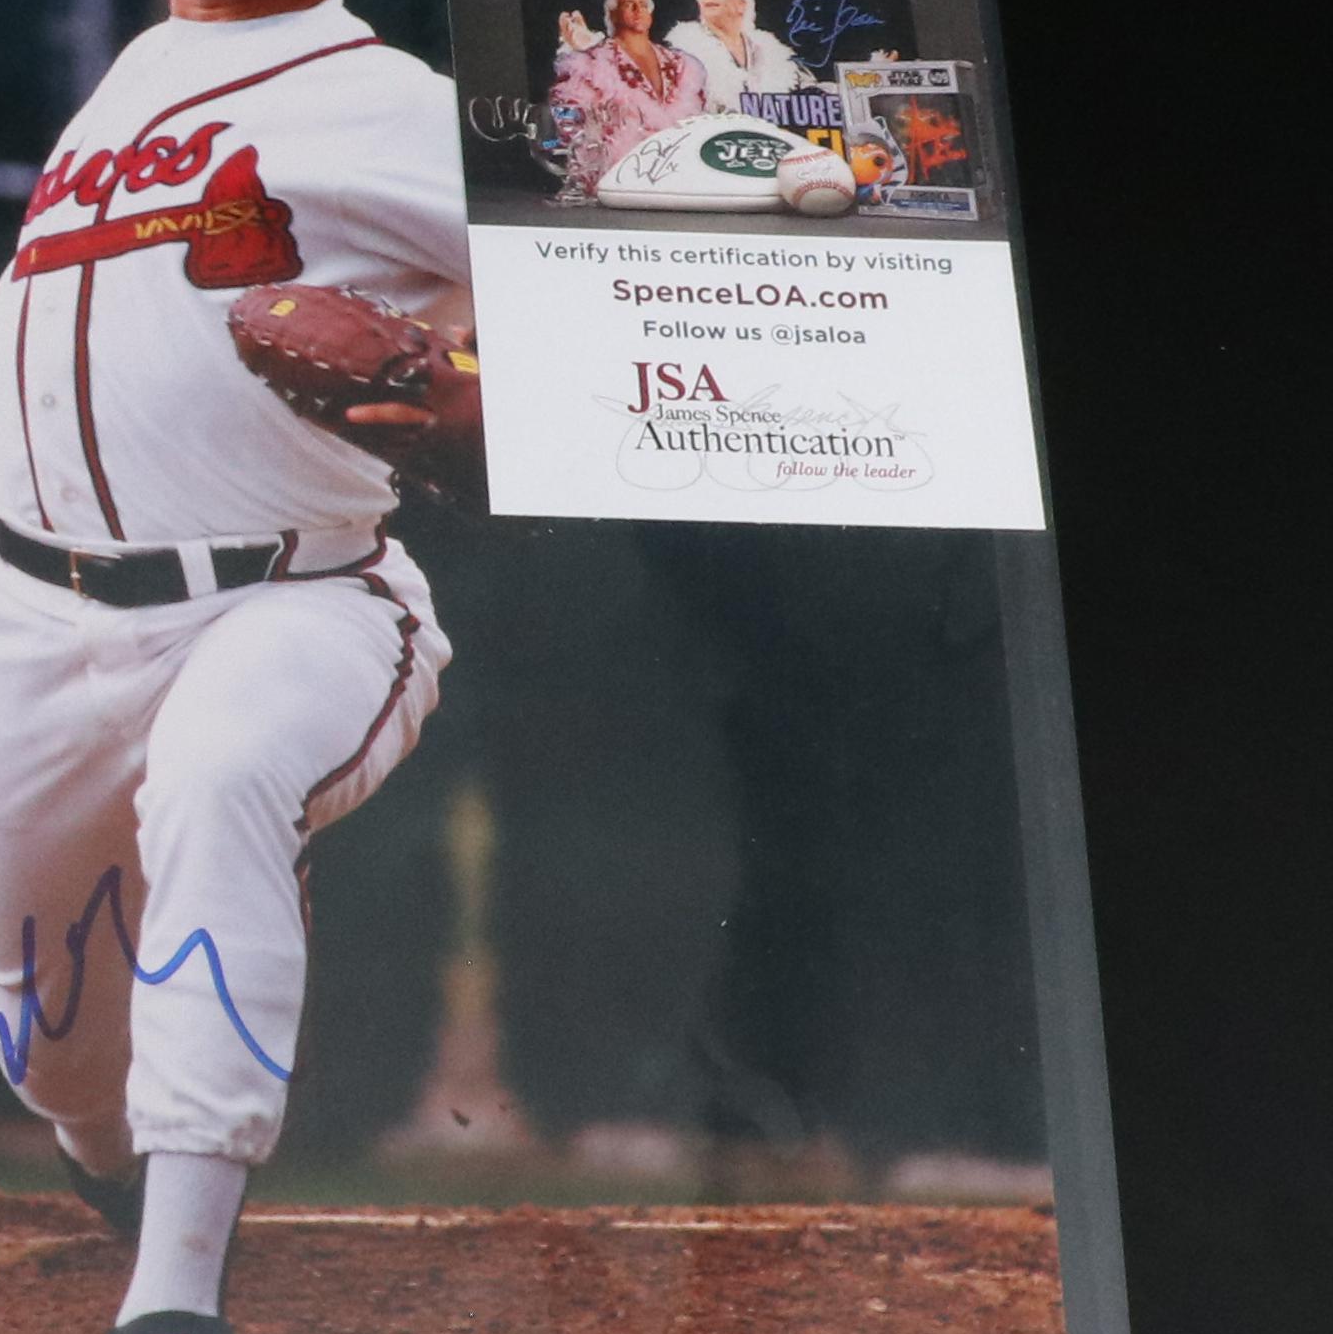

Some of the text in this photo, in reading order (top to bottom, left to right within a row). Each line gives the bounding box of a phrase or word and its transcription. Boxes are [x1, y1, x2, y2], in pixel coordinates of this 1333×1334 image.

[741, 93, 842, 128] NATURE
[535, 241, 953, 275] Verify this certification by visiting
[612, 279, 888, 310] SpenceLOA.com
[643, 320, 866, 346] Follow us @jsaloa
[628, 362, 730, 413] JSA
[656, 404, 780, 427] James Spence
[777, 461, 916, 480] follow the leader
